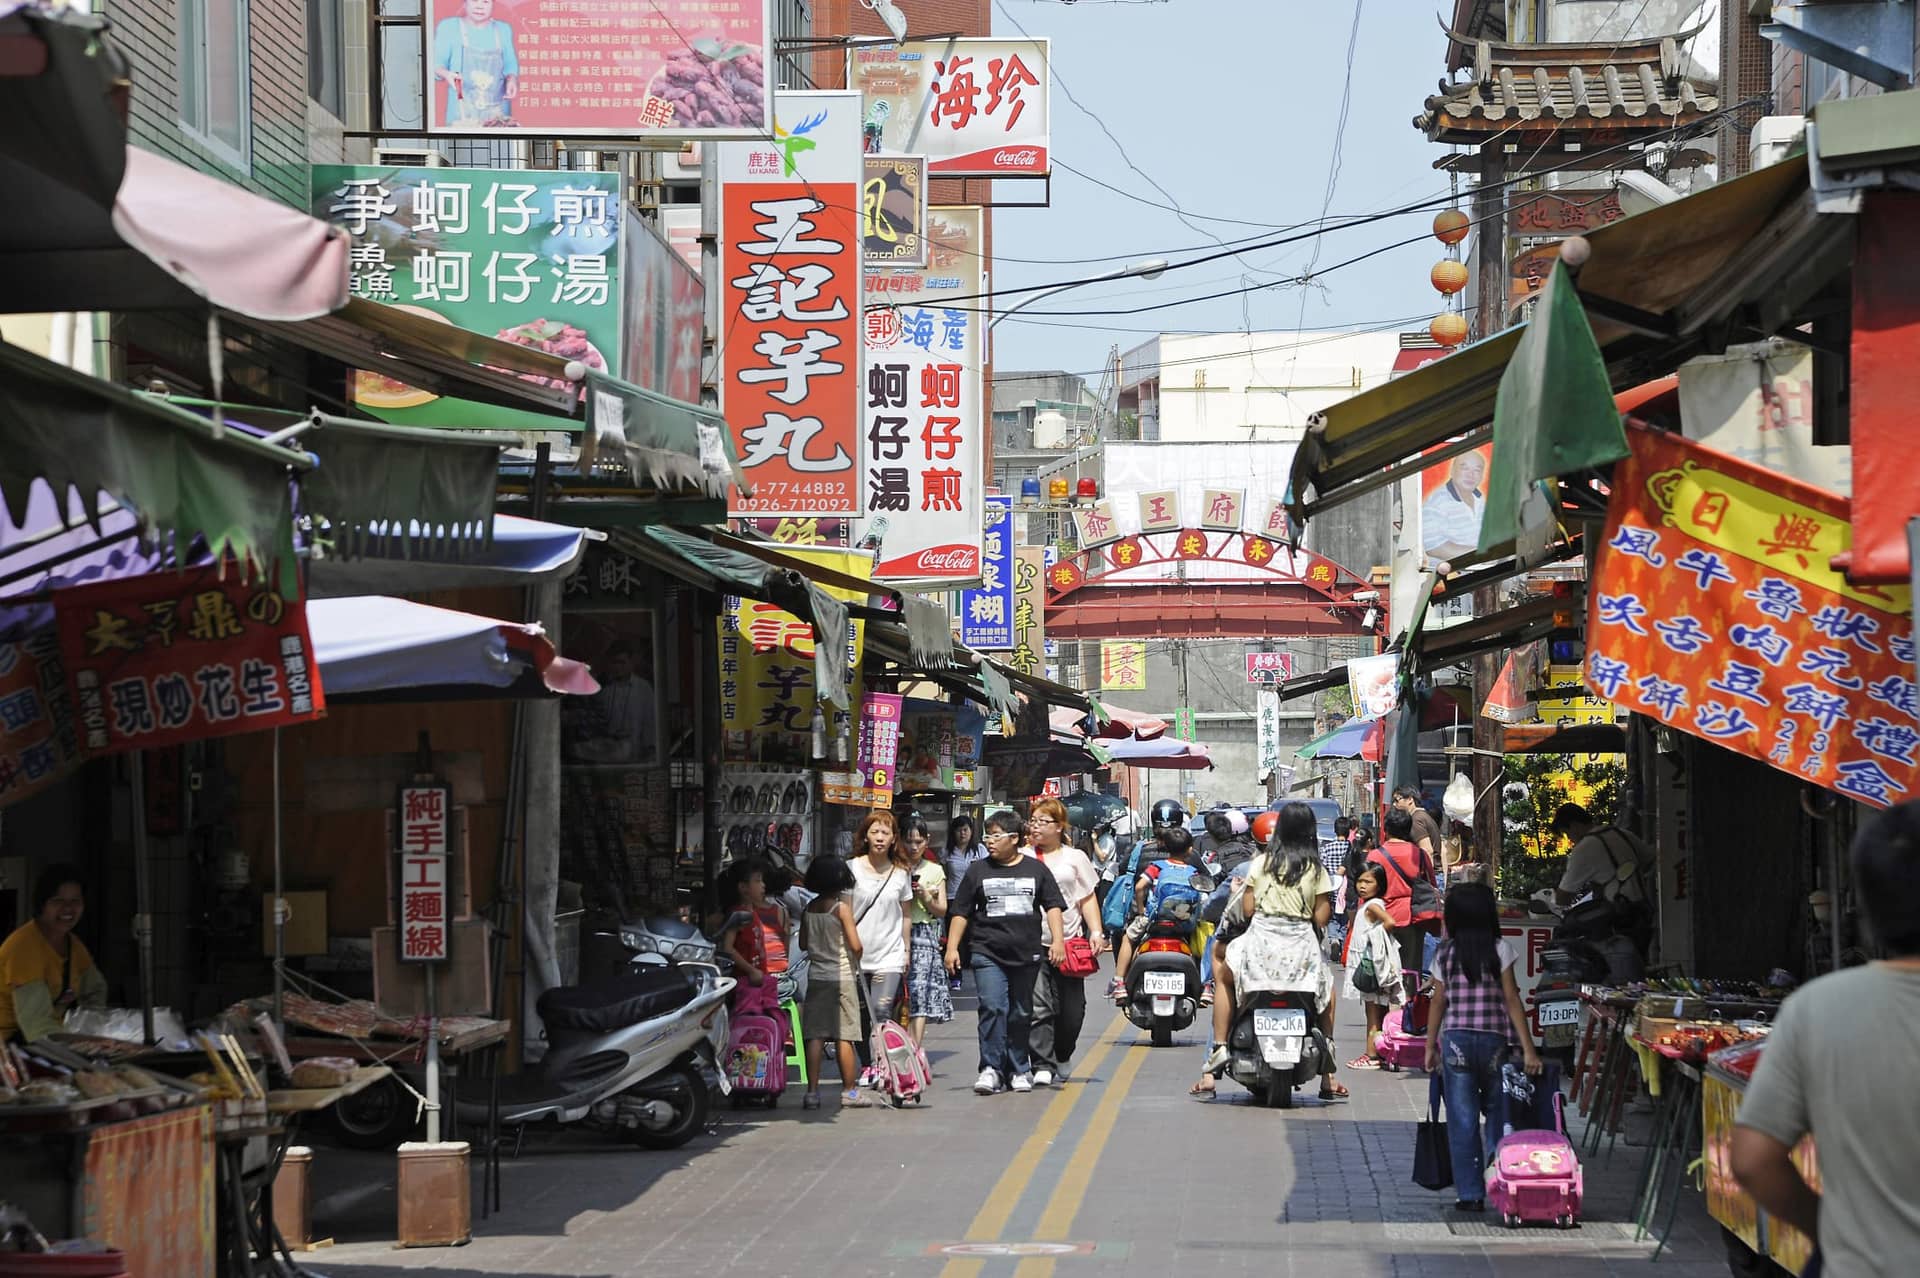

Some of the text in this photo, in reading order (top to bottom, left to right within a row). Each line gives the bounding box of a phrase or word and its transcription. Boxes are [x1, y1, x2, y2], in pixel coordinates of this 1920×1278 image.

[640, 96, 675, 128] 鮮
[748, 152, 779, 167] 鹿港
[994, 150, 1039, 166] Coca-Cola
[412, 183, 610, 238] 蚵仔煎
[412, 251, 611, 306] 蚵仔湯
[731, 197, 853, 473] 王記芋丸
[868, 313, 893, 339] 郭
[868, 363, 911, 512] 蚵仔湯
[920, 363, 963, 512] 蚵仔煎
[737, 498, 851, 511] 0926-712092
[917, 549, 976, 570] Coca-Cola
[280, 635, 314, 714] 鹿港名產
[873, 769, 887, 786] 6
[405, 790, 444, 957] 純手工麵線
